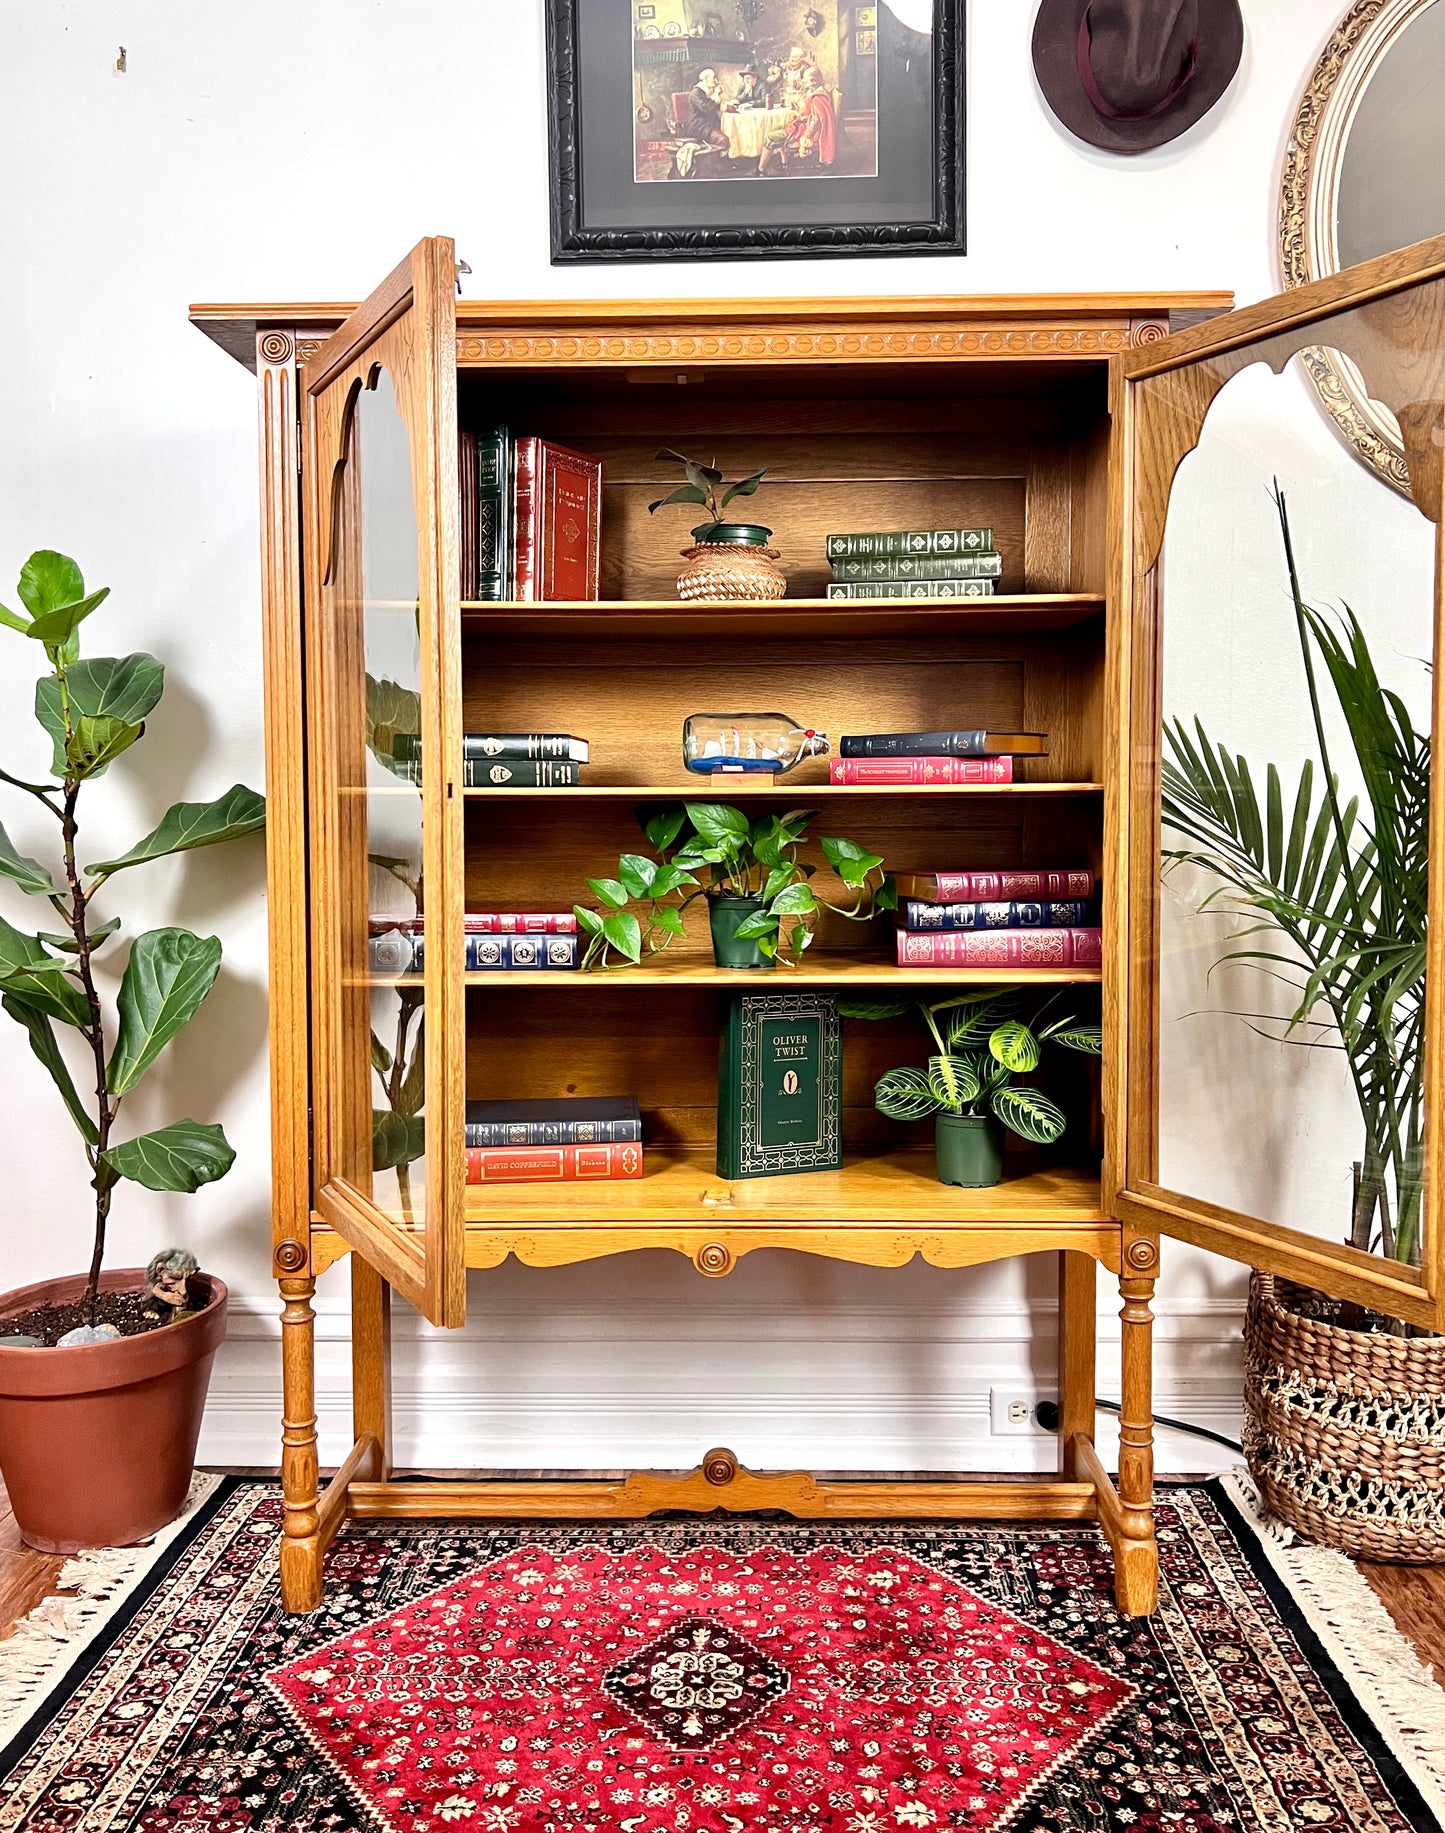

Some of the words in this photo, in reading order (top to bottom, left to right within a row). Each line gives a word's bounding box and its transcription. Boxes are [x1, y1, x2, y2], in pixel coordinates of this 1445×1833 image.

[773, 1035, 808, 1045] OLIVER
[775, 1046, 806, 1056] TWIST
[487, 1162, 508, 1170] DAVID
